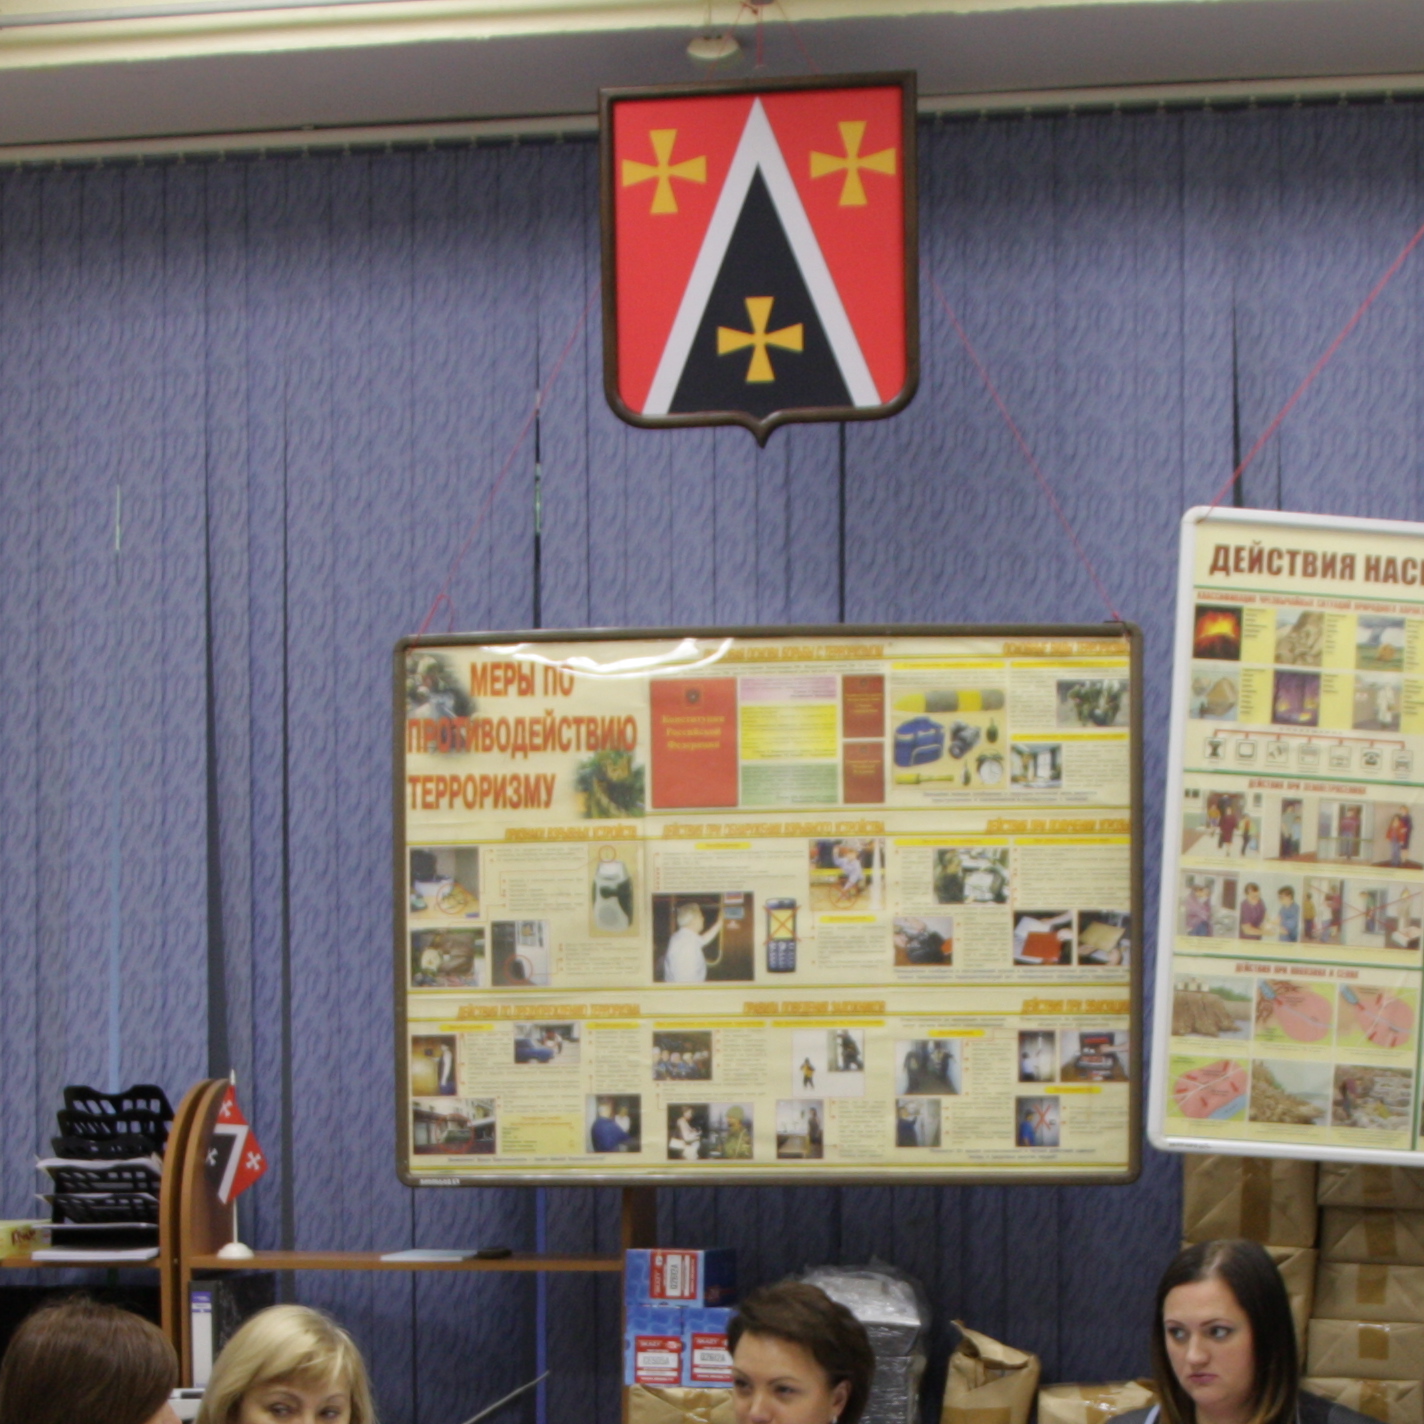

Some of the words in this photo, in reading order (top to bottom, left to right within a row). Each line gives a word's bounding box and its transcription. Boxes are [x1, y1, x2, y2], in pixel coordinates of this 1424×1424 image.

[1209, 540, 1357, 581] ДЕЙСТВИЯ
[469, 661, 536, 697] МЕРЫ
[543, 663, 575, 697] ПО
[407, 709, 638, 760] ПРОТИВОДЕЙСТВИЮ
[407, 773, 557, 811] ТЕРРОРИЗМУ
